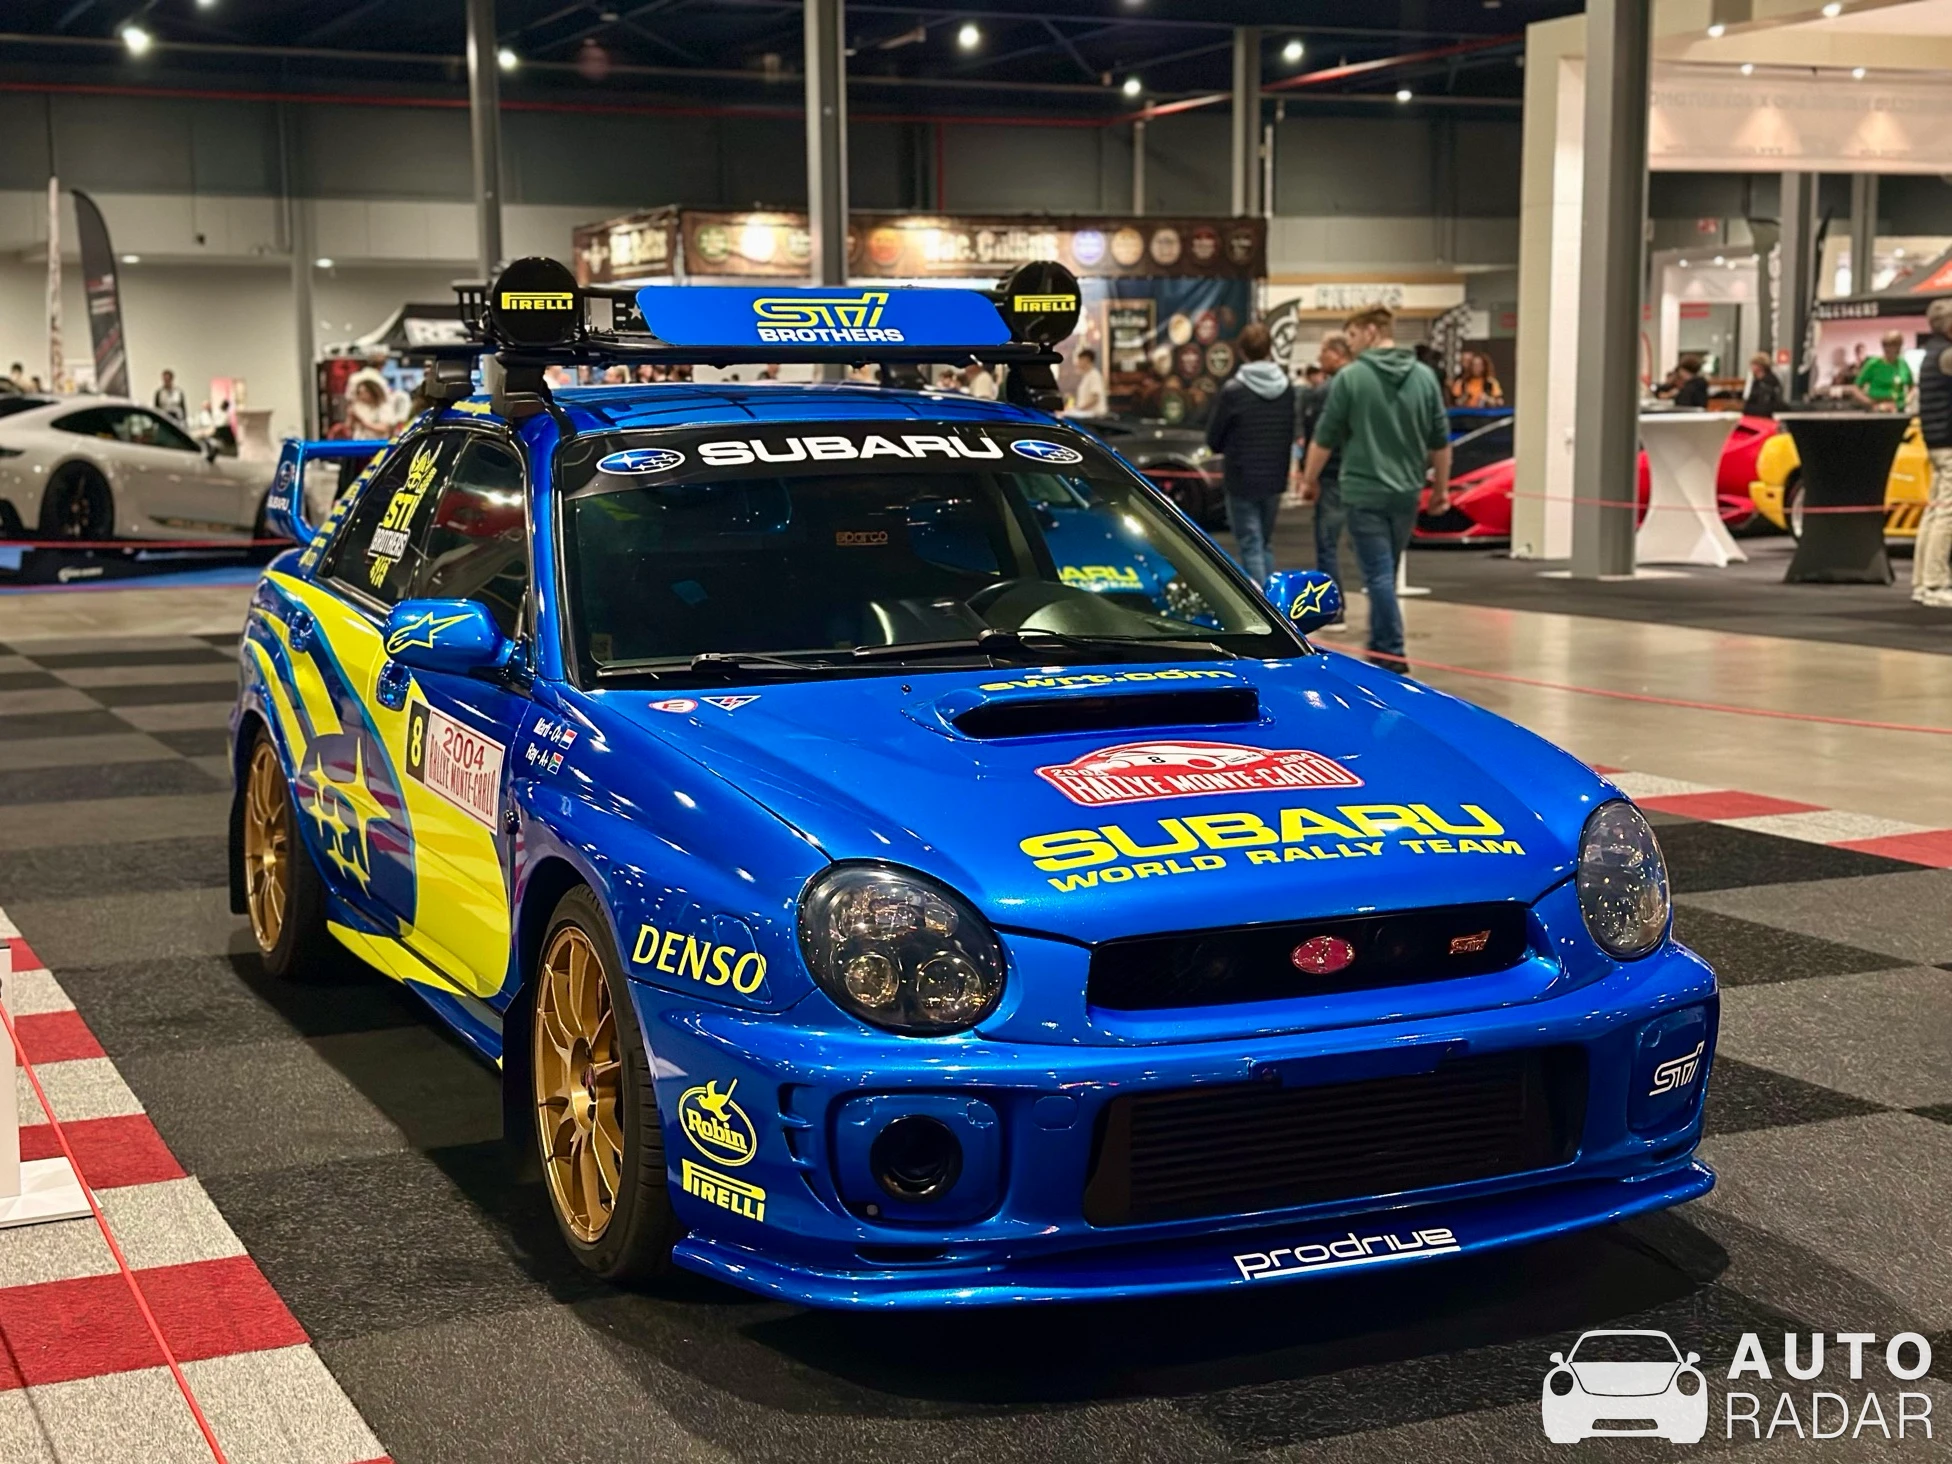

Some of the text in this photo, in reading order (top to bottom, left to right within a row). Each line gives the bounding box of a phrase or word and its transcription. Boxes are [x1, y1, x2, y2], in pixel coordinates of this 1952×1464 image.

[501, 292, 574, 310] PIRELLI
[1013, 294, 1076, 312] PIRELLI
[757, 328, 905, 343] BROTHERS
[697, 434, 1003, 466] SUBARU
[370, 529, 409, 558] BROTHERS
[979, 669, 1237, 691] swrt.com
[411, 715, 423, 767] 8
[443, 726, 485, 771] 2004
[1151, 755, 1167, 765] 8
[1273, 752, 1315, 766] 2004
[428, 733, 496, 817] RALLYE MONTE-CARLO
[1065, 758, 1349, 804] RALLYE MONTE-CARLO
[1019, 804, 1505, 873] SUBARU
[1047, 837, 1527, 893] WORLD RALLY TEAM
[632, 924, 768, 995] DENSO
[686, 1107, 748, 1154] Robin
[681, 1158, 766, 1222] PIRELLI
[1234, 1227, 1461, 1282] prodrive
